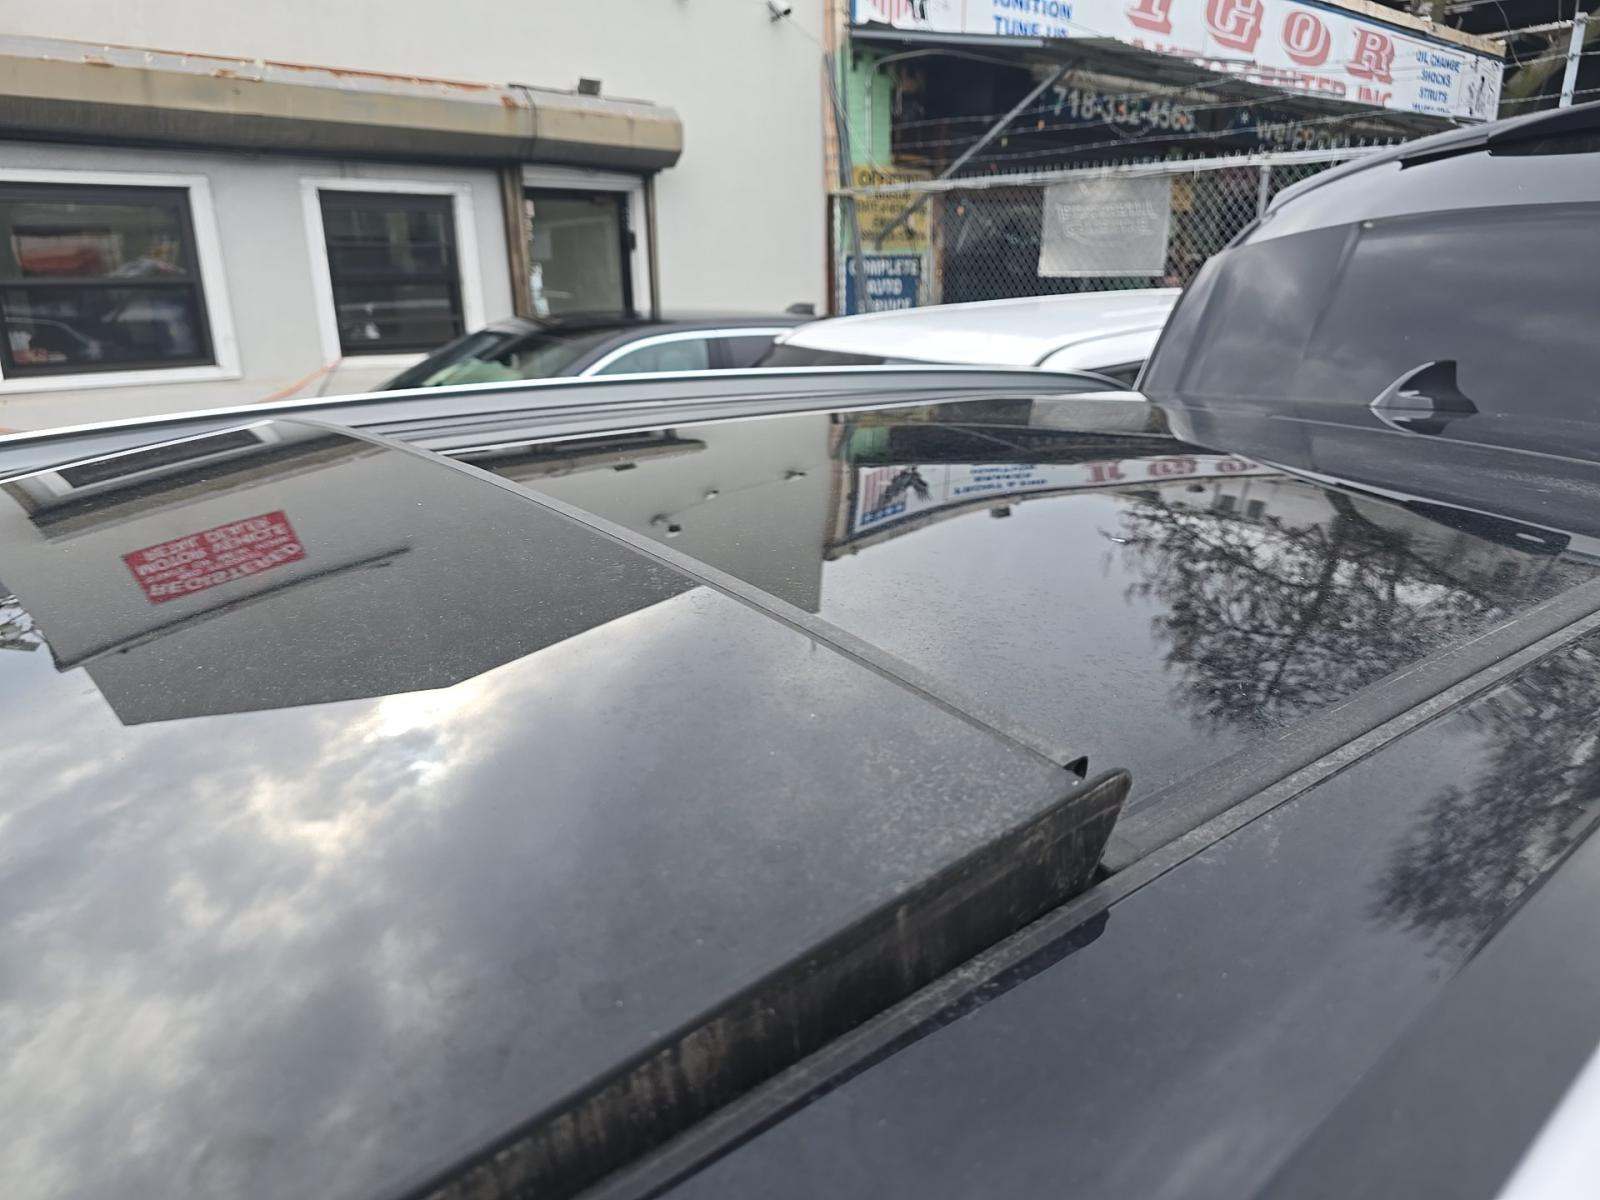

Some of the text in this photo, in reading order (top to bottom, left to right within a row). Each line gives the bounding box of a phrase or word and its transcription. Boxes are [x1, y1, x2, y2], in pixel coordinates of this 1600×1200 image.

[993, 0, 1072, 20] NITION
[1126, 0, 1395, 84] IGOR
[1416, 50, 1461, 73] OIL CHANGE
[1420, 69, 1452, 88] SHOCKS
[1418, 86, 1448, 104] STRUTS
[847, 258, 920, 277] CMPLETE
[865, 278, 903, 296] AUTO
